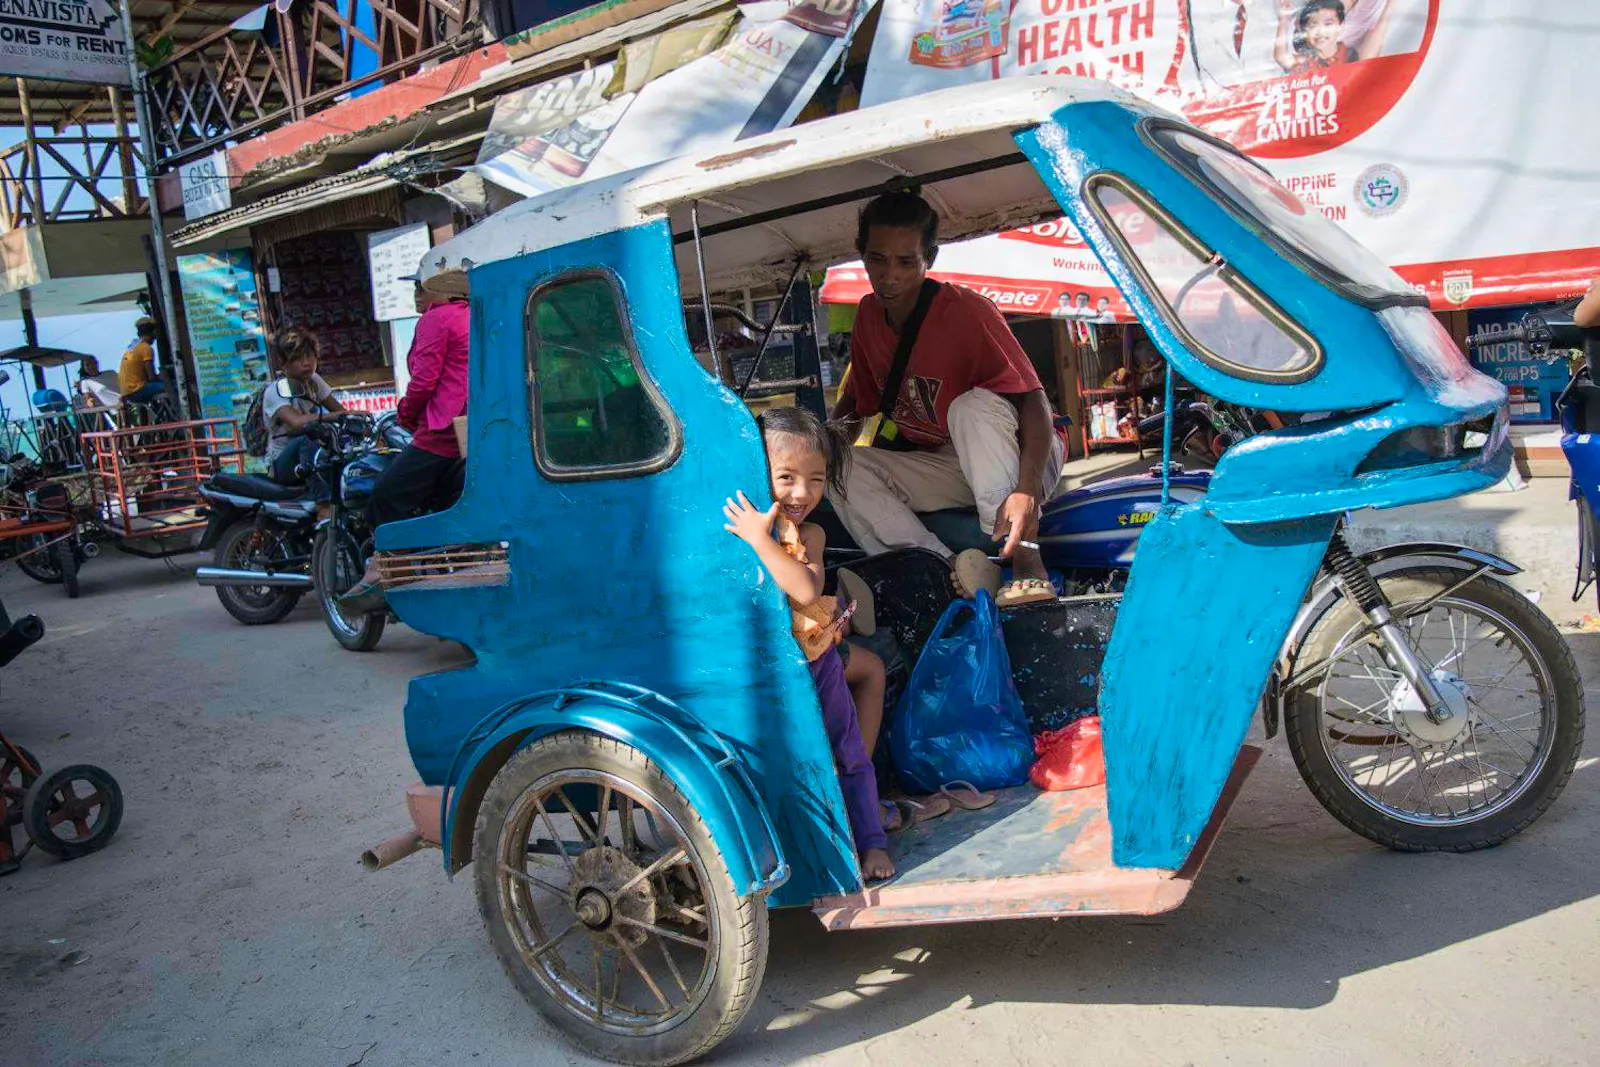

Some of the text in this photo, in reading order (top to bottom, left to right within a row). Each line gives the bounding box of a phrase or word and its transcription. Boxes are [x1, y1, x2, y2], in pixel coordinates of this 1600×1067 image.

[0, 26, 127, 55] OMS FOR RENT
[1018, 3, 1154, 66] HEALTH
[1257, 84, 1337, 126] ZERO
[1257, 114, 1339, 144] CAVITIES
[190, 160, 218, 185] CASA
[1495, 368, 1503, 381] 2
[1520, 366, 1539, 381] P5
